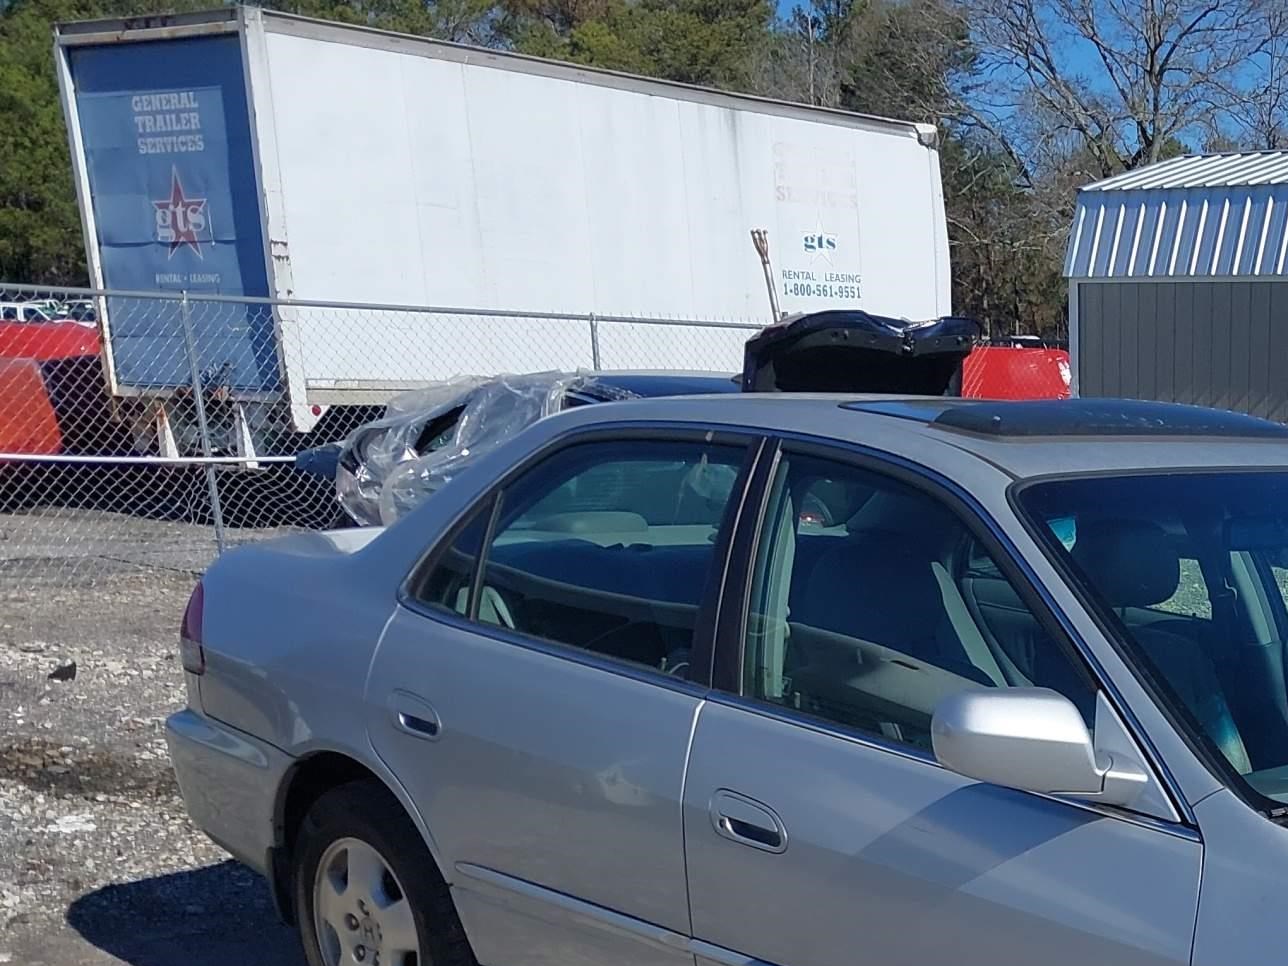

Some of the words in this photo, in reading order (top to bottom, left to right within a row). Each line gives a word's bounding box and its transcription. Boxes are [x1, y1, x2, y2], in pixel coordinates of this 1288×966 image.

[132, 92, 199, 112] GENERAL
[134, 112, 200, 133] TRAILER
[137, 135, 205, 154] SERVICES
[155, 200, 206, 242] gts
[804, 232, 836, 253] gts
[782, 269, 817, 281] RENTAL
[824, 272, 861, 283] LEASING
